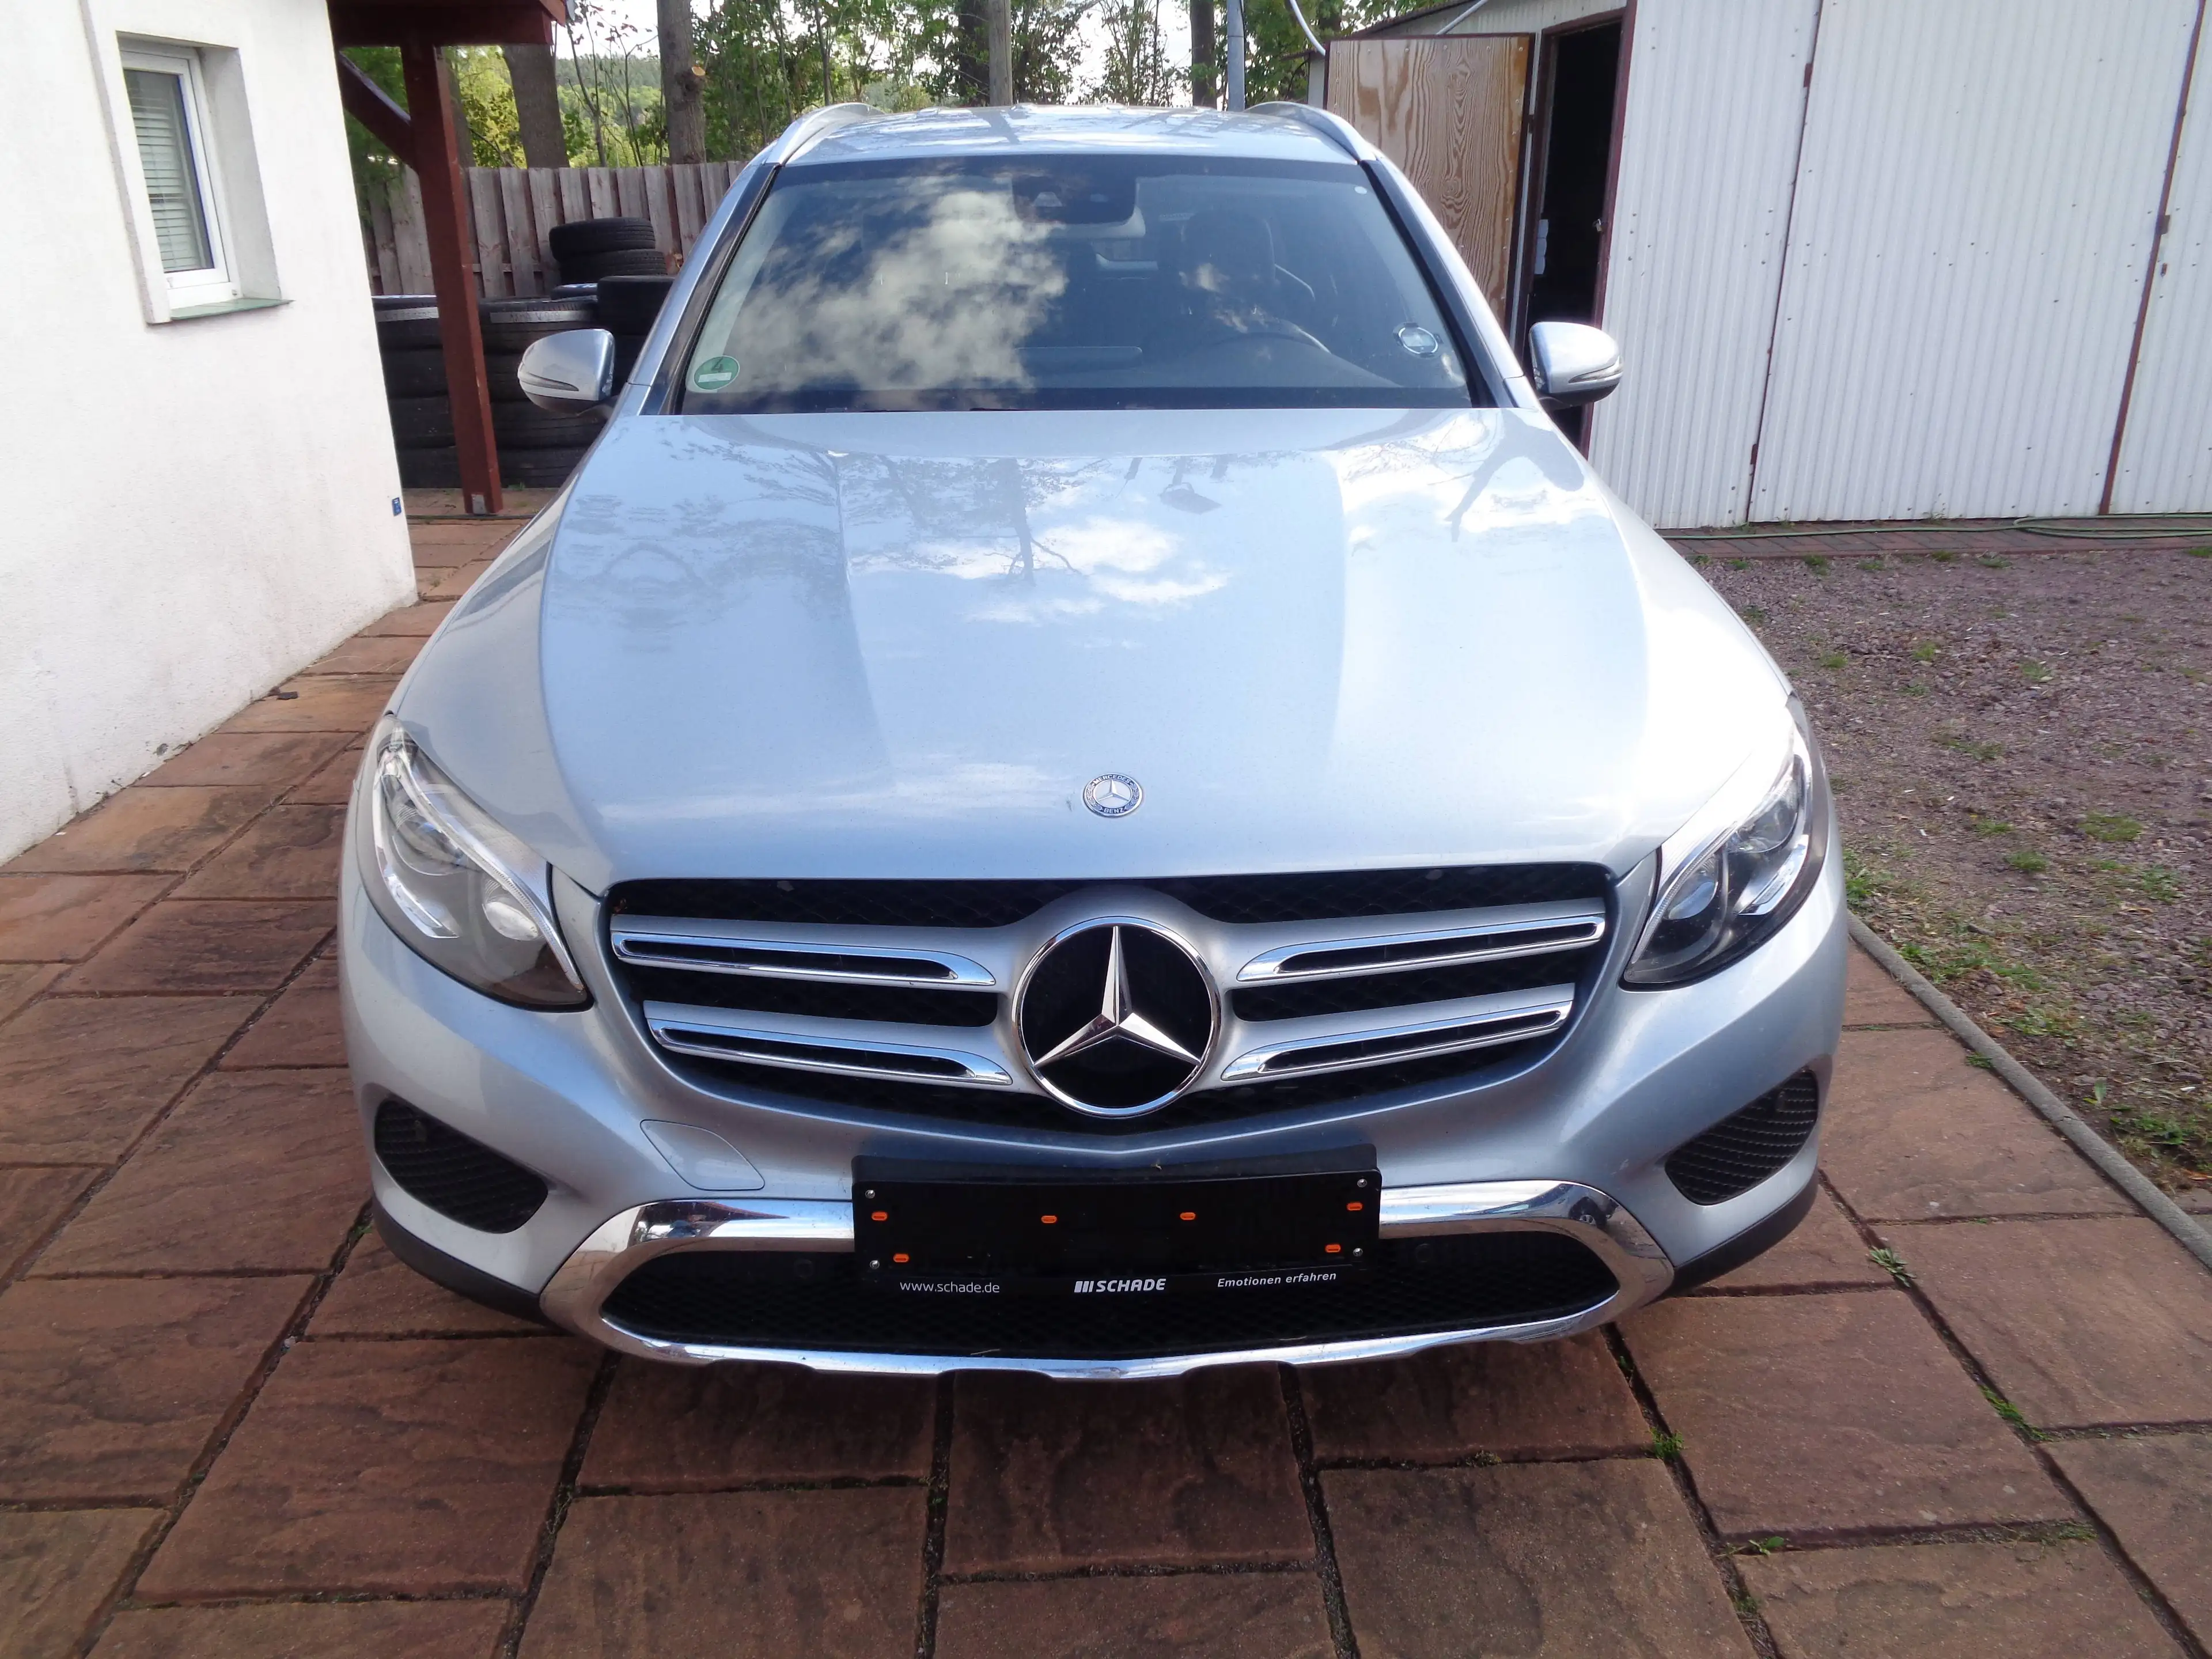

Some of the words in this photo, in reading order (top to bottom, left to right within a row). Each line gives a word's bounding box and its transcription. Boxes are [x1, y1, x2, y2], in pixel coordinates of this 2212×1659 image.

[711, 358, 724, 373] 4
[1092, 774, 1131, 784] MERCEDES
[1096, 1278, 1166, 1292] SCHADE
[1217, 1277, 1282, 1287] Emotionen
[1285, 1272, 1336, 1283] erfahren
[899, 1281, 1000, 1293] www.schade.de
